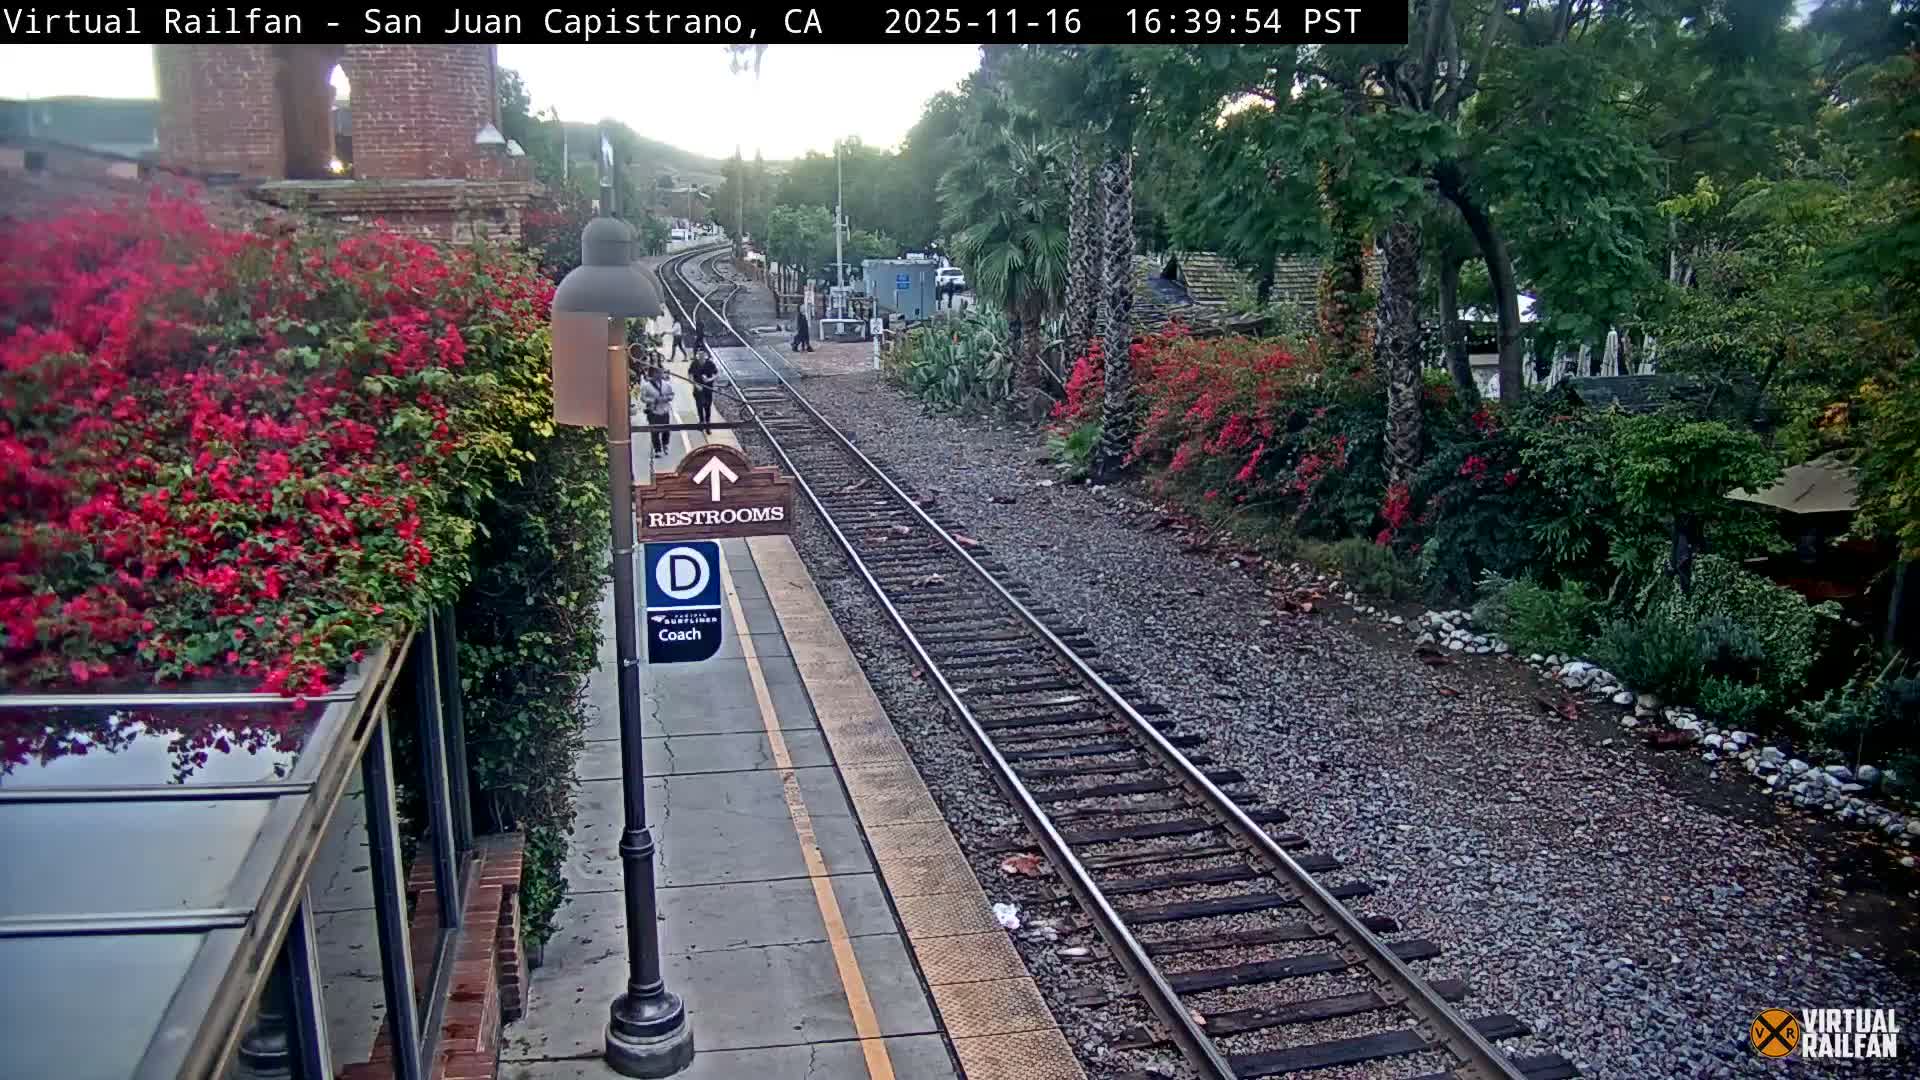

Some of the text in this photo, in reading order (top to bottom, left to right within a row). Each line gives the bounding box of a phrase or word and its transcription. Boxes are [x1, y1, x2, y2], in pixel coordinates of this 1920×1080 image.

[648, 506, 784, 528] RESTROOMS
[669, 554, 702, 592] D
[658, 627, 702, 642] Coach
